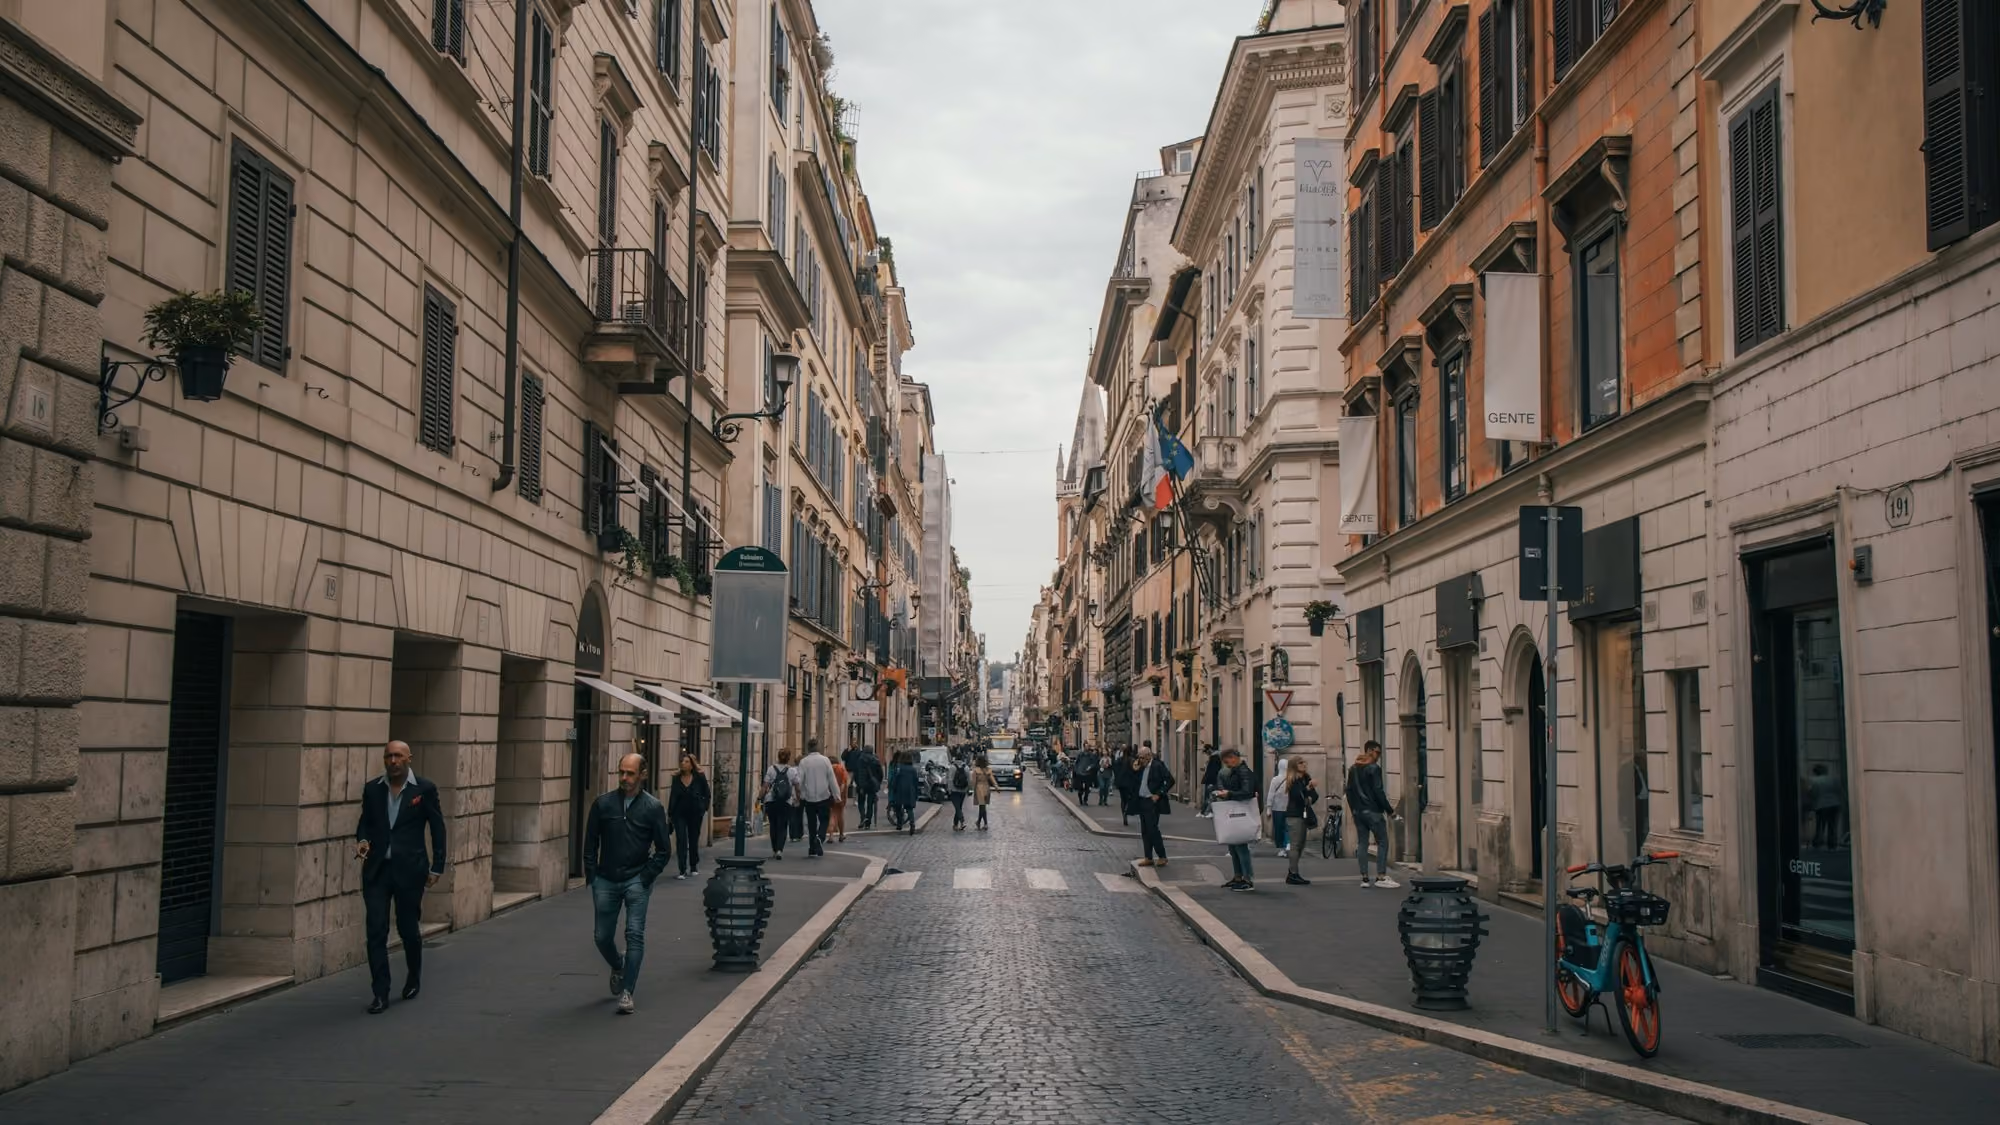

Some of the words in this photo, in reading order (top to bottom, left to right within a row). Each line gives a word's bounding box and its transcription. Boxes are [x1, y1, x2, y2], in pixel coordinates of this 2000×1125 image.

[1488, 412, 1536, 424] GENTE
[1890, 496, 1908, 519] 191
[1342, 514, 1375, 523] GENTE
[1789, 859, 1821, 877] GENTE
